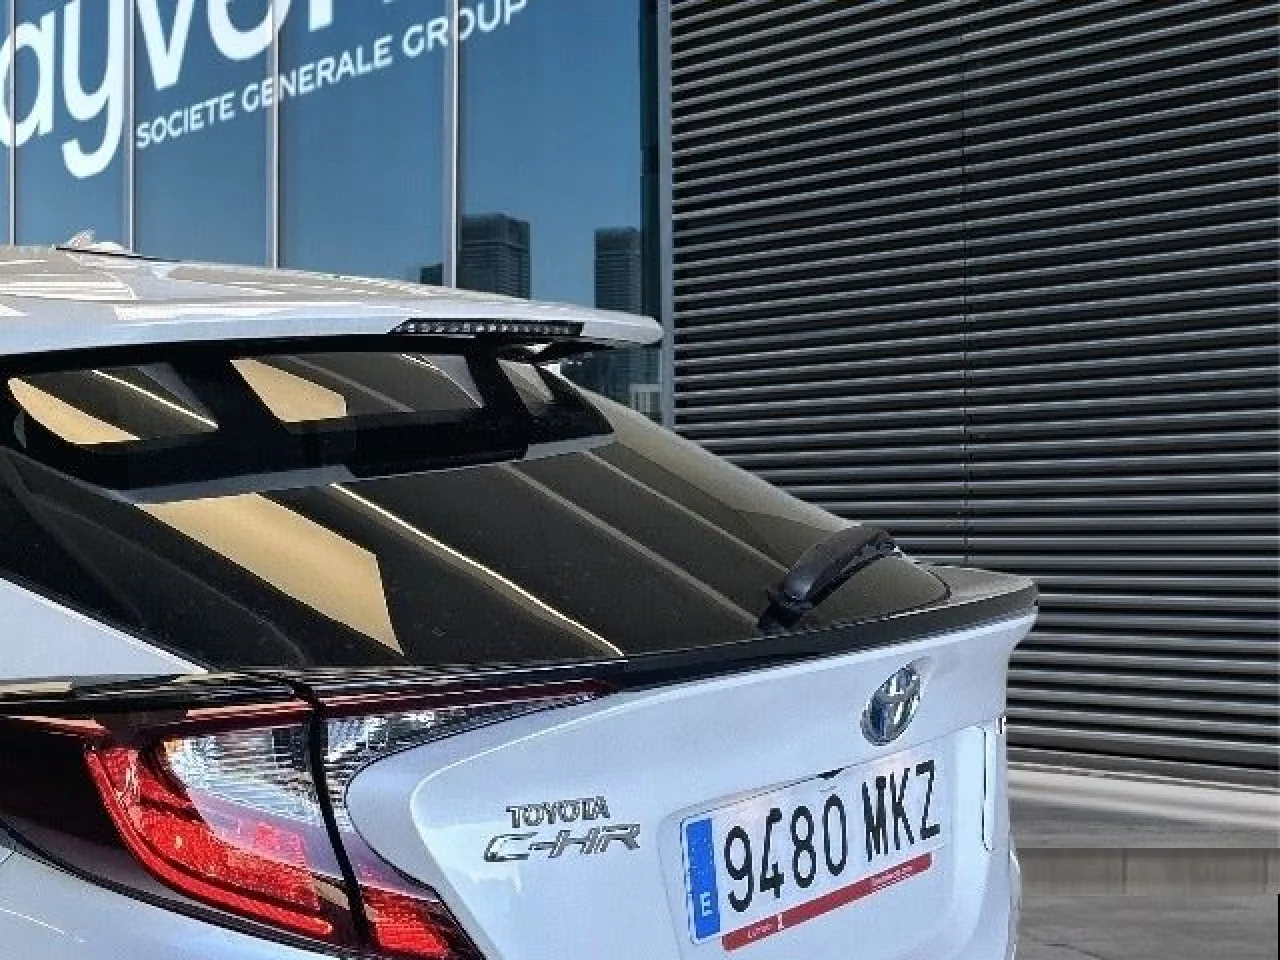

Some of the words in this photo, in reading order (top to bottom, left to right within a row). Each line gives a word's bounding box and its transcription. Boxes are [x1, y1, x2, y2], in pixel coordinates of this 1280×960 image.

[136, 92, 236, 149] SOCIETE
[241, 34, 394, 112] GENERALE
[401, 0, 528, 58] GROUP
[506, 796, 610, 828] TOYOTA
[483, 824, 640, 862] C-HR
[724, 794, 848, 912] 9480
[862, 760, 941, 863] MKZ
[699, 891, 714, 917] E
